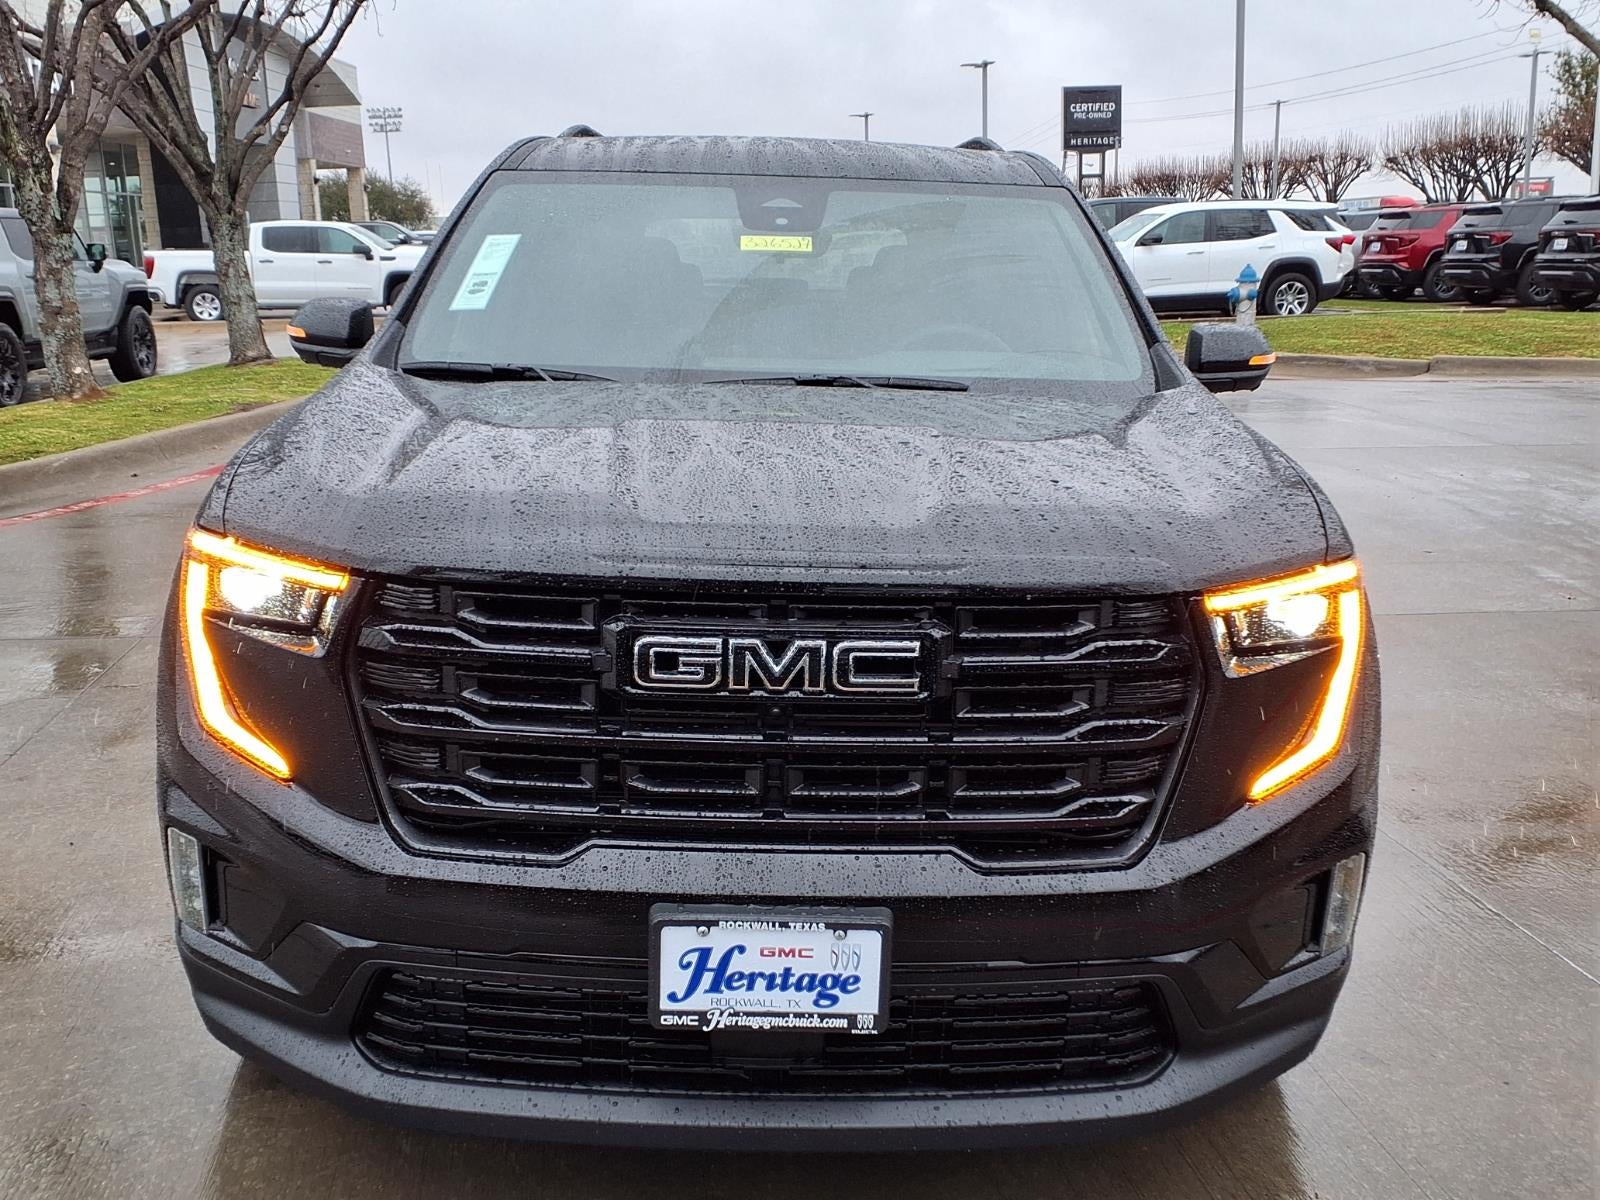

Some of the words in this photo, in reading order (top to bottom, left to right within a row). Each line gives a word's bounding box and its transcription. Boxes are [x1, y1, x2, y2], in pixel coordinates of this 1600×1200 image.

[1070, 102, 1116, 112] CERTIFIED
[1073, 111, 1112, 119] PRE-OWNED
[1070, 136, 1114, 146] HERITAGE
[633, 635, 920, 691] GMC
[789, 922, 826, 932] TEXAS
[759, 946, 814, 958] GMC
[666, 943, 862, 1009] Heritage
[786, 999, 801, 1009] TX
[660, 1014, 699, 1026] GMC
[702, 1007, 848, 1032] Heritagegmcbuick.com
